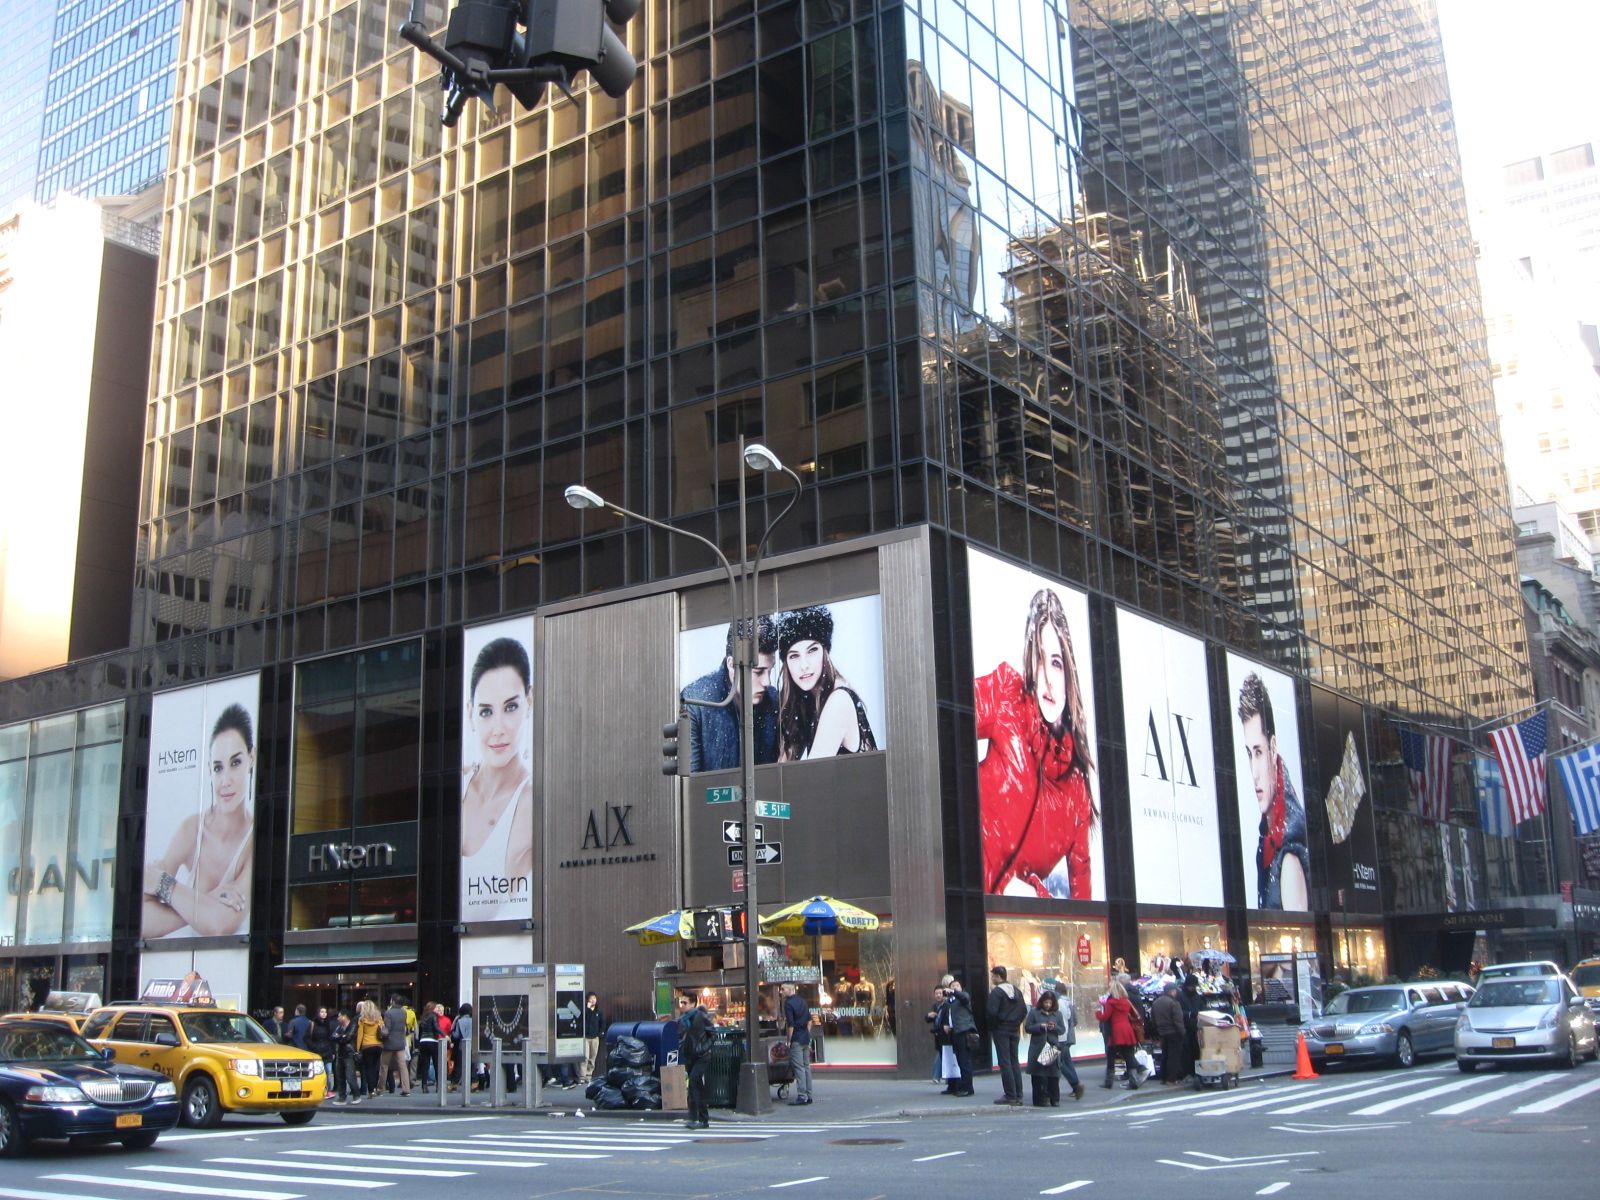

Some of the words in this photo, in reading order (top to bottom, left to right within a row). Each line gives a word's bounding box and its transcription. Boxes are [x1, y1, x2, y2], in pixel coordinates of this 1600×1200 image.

[712, 789, 720, 801] 5
[763, 805, 768, 815] E
[771, 804, 780, 816] 51
[560, 858, 598, 869] ARMANI
[601, 853, 657, 865] EXCHANGE
[841, 916, 877, 926] SABRETT
[144, 981, 176, 998] Annie
